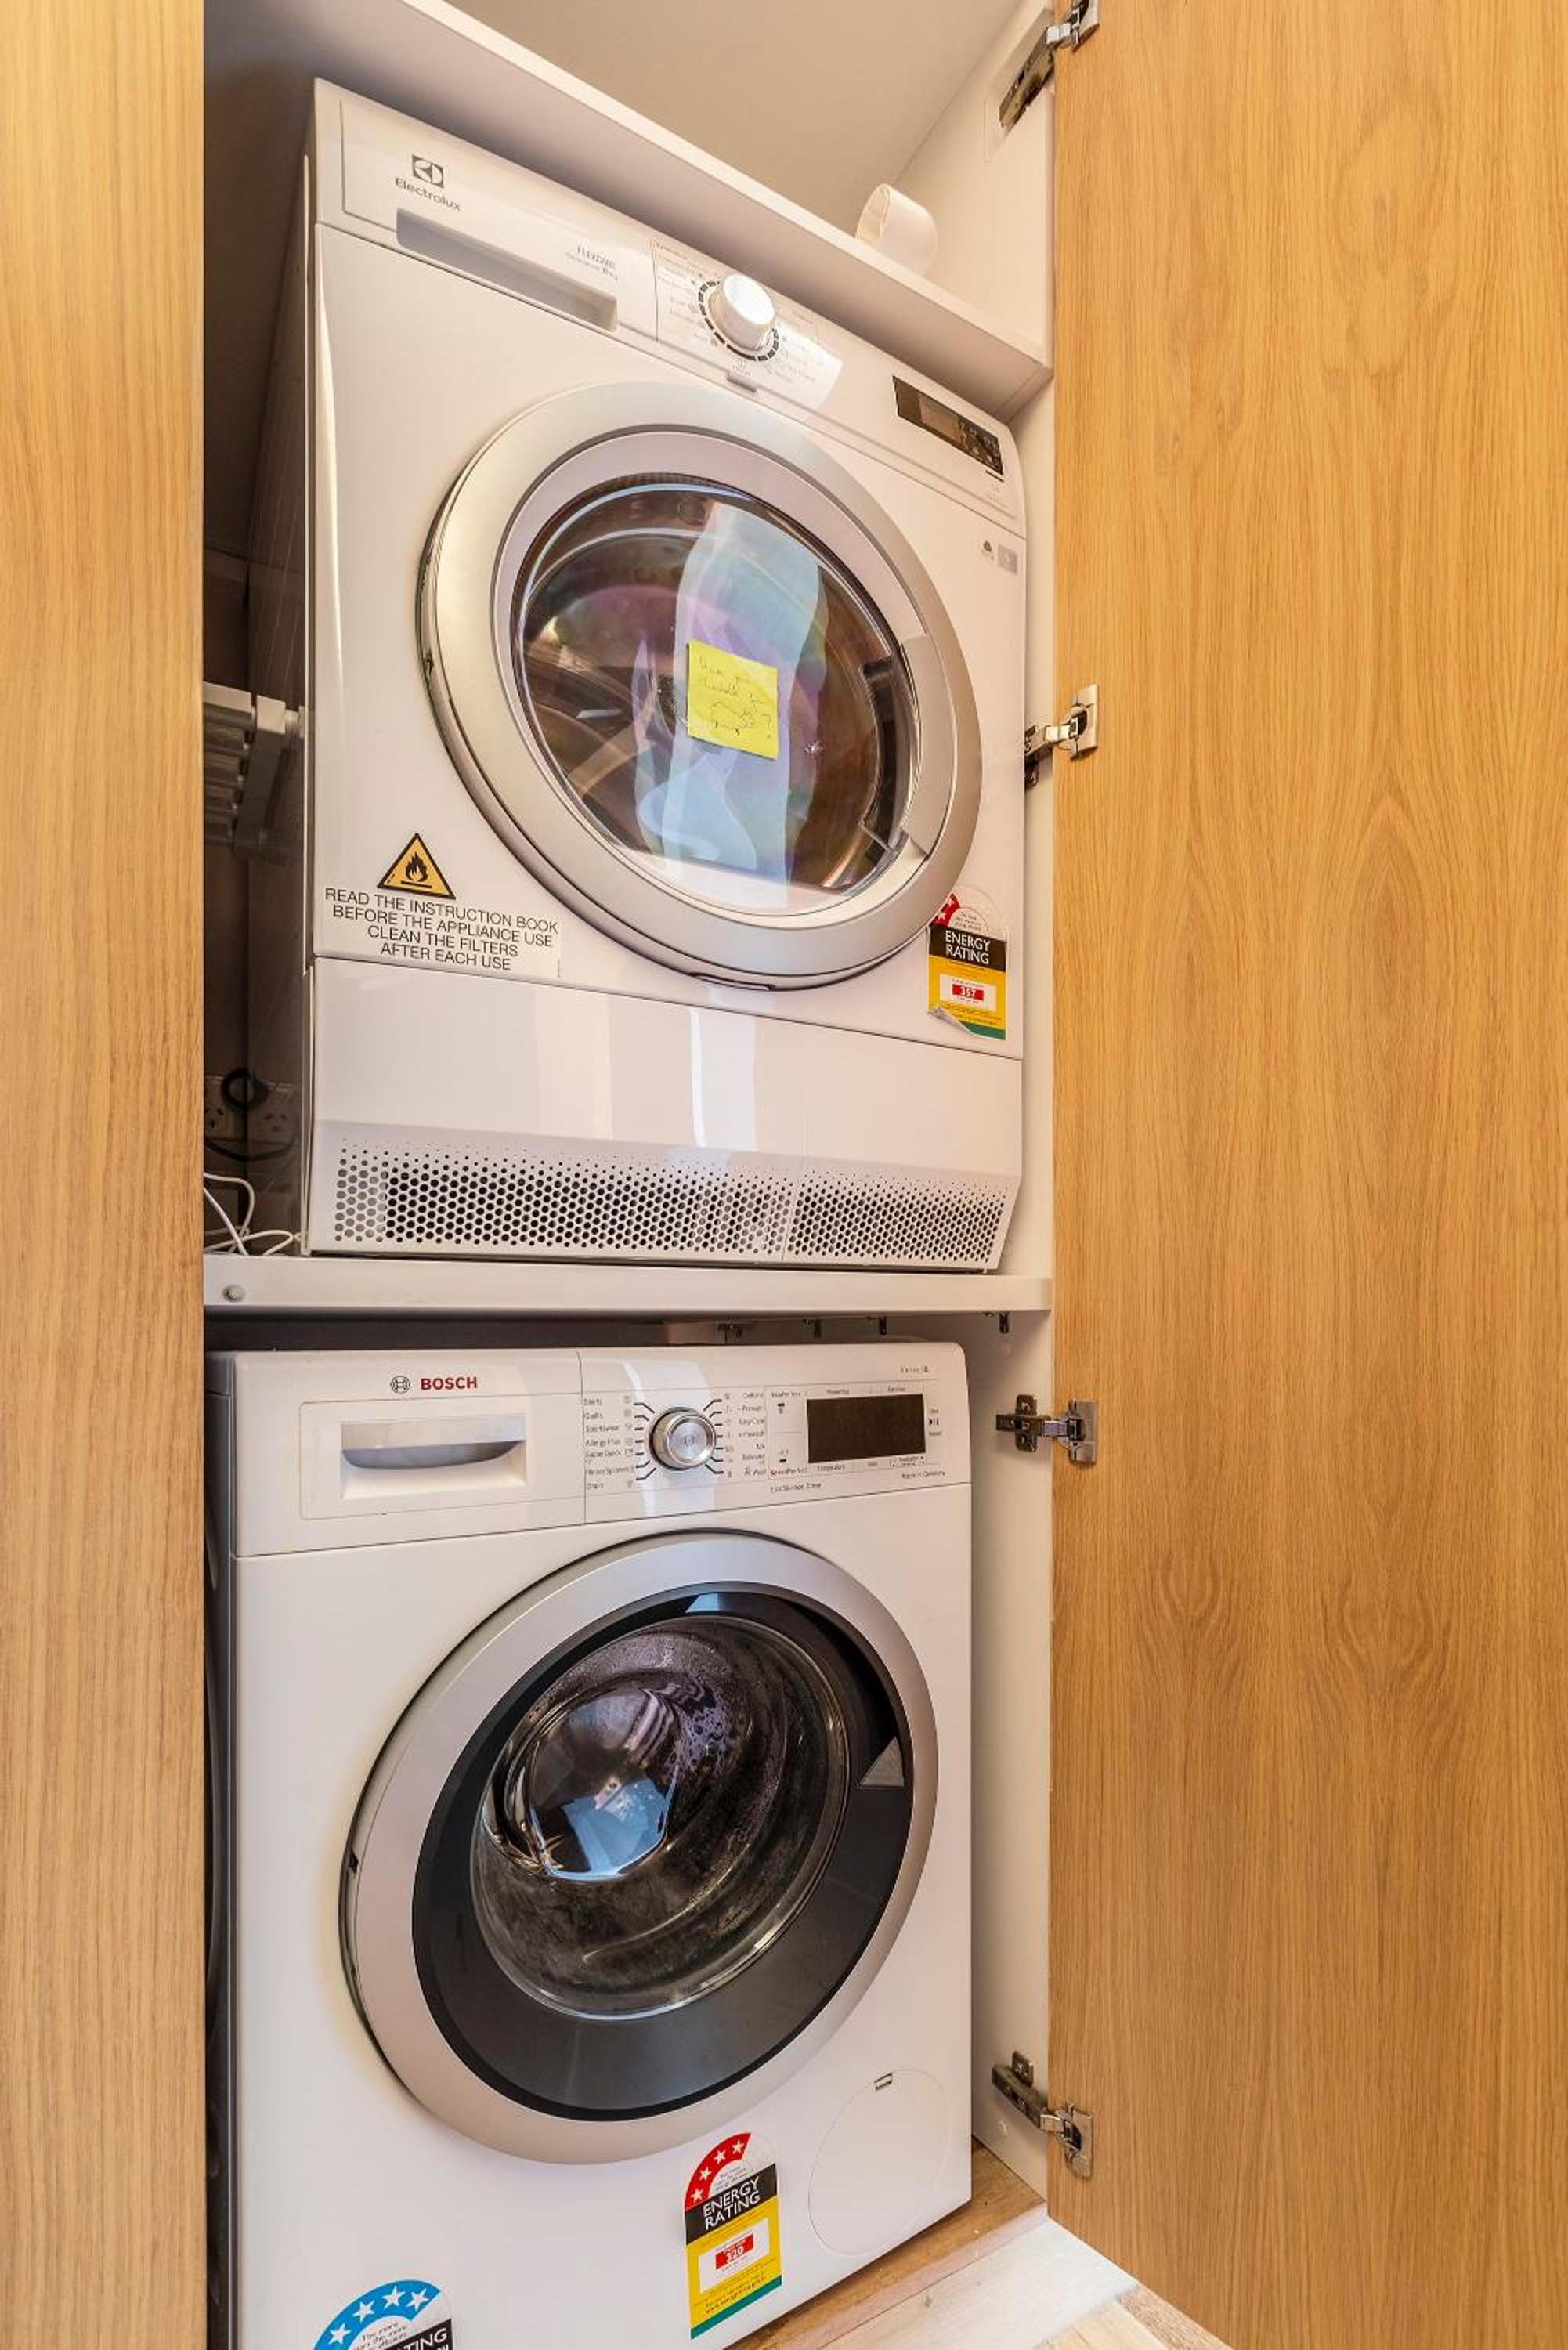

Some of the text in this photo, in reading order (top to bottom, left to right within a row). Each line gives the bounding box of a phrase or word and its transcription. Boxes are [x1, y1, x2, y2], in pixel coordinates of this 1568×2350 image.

[395, 176, 461, 212] Electrolux
[325, 887, 558, 935] READ THE INSTRUCTION BOOK
[333, 905, 553, 948] BEFORE THE APPLIANCE USE
[367, 924, 518, 957] CLEAN THE FILTERS
[380, 942, 511, 971] AFTER EACH USE
[945, 930, 990, 952] ENERGY
[945, 943, 989, 965] RATING
[421, 1376, 477, 1390] BOSCH
[703, 2176, 759, 2218] ENERGY
[706, 2190, 761, 2231] RATING
[398, 2328, 447, 2350] TING
